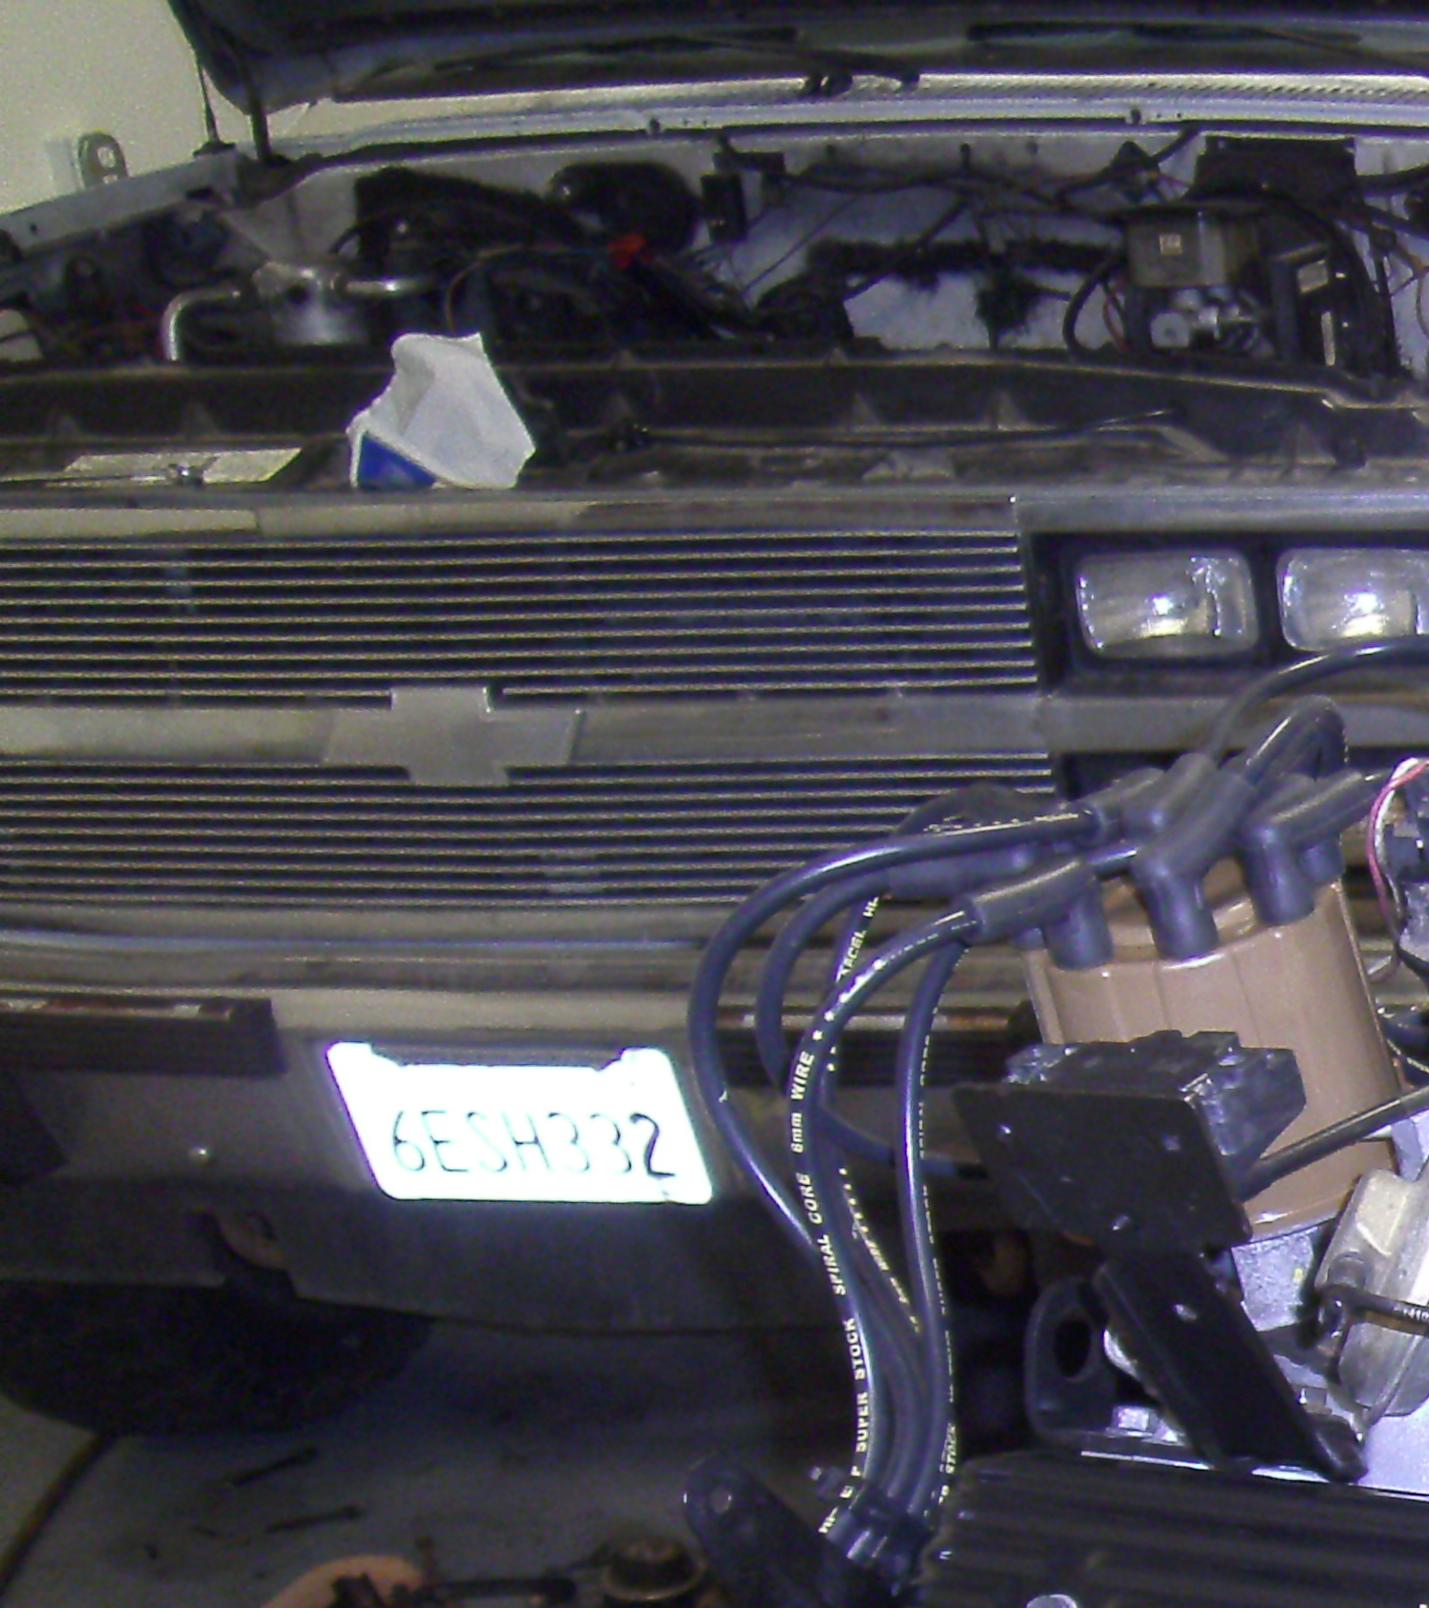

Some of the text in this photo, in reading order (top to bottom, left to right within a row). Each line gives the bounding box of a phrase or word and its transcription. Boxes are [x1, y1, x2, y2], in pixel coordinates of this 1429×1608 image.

[790, 1051, 815, 1100] WIRE
[392, 1110, 676, 1177] 6ESH332
[795, 1172, 823, 1225] CORE
[817, 1234, 846, 1296] SPIRAL
[843, 1317, 866, 1380] STOCK
[856, 1392, 869, 1452] SUPER
